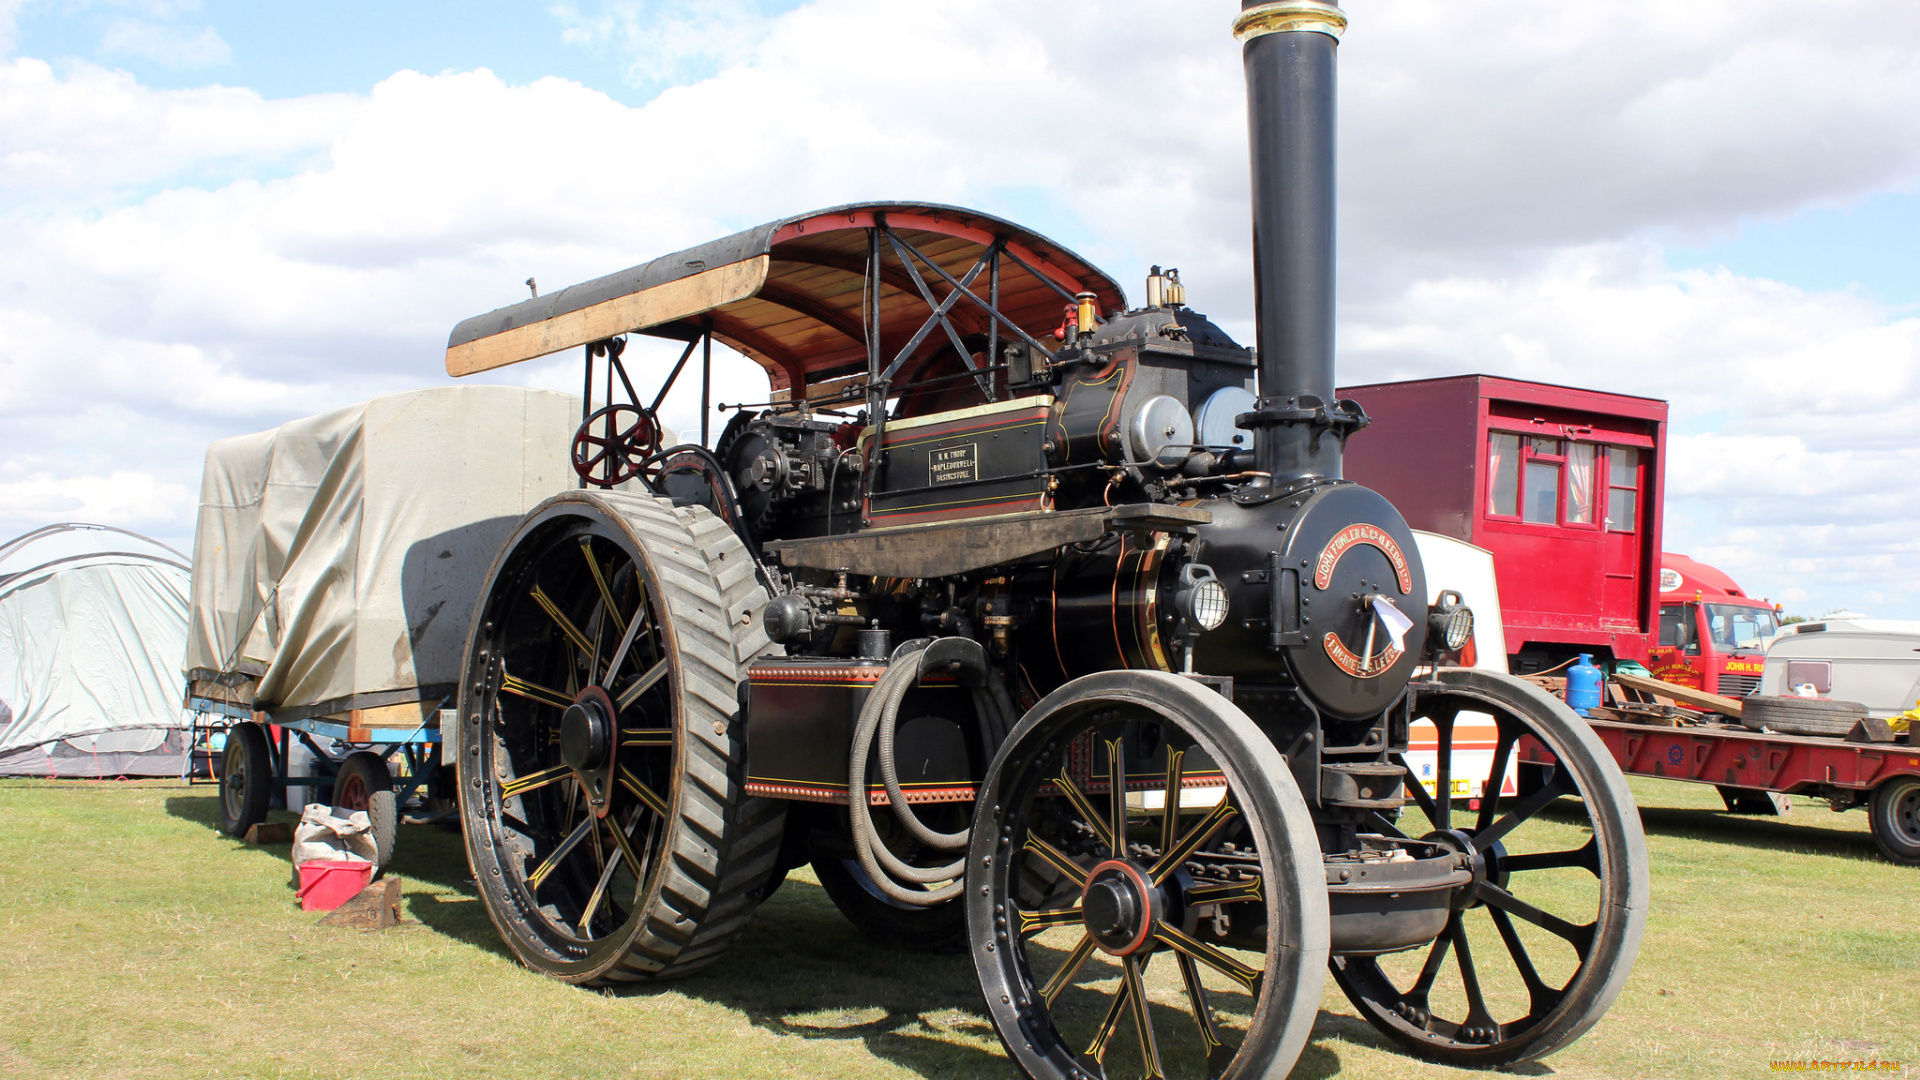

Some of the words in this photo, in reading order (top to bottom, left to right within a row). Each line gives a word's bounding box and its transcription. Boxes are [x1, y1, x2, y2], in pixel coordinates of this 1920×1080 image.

[1319, 550, 1335, 581] JOHN
[1330, 528, 1361, 555] FOWLER
[1361, 527, 1369, 539] &
[1379, 535, 1404, 570] (LEEDS)
[1653, 664, 1665, 676] JOHN
[1671, 663, 1692, 672] RUNDLE
[1726, 661, 1745, 671] JOHN
[1746, 662, 1753, 672] H.
